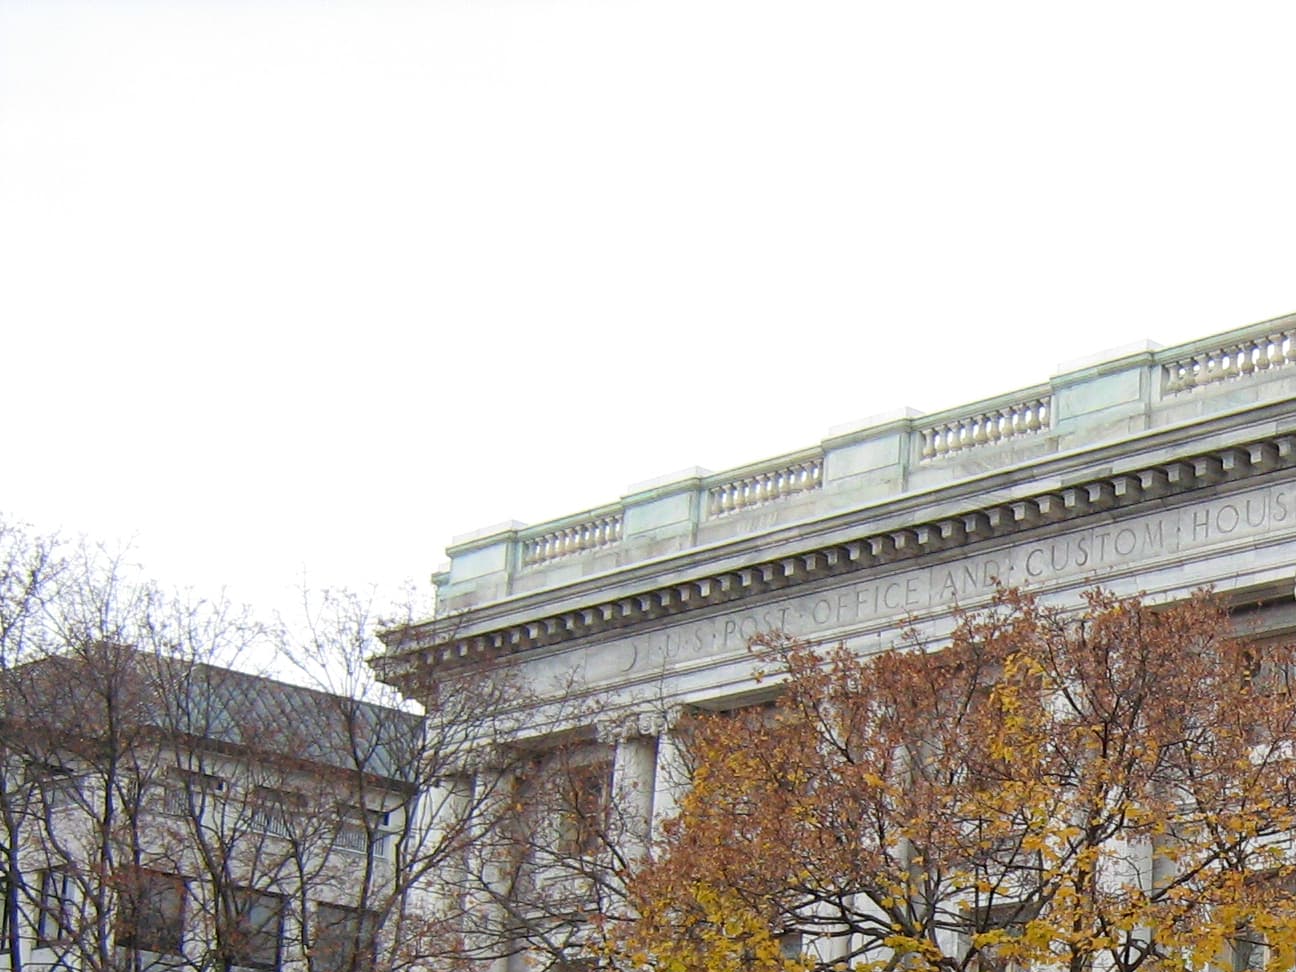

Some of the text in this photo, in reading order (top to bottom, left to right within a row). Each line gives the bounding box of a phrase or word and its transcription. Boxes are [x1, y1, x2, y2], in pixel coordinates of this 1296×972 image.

[723, 606, 791, 647] POST
[810, 577, 921, 625] OFFICE
[939, 559, 1001, 600] AND
[1025, 520, 1165, 577] CUSTOM
